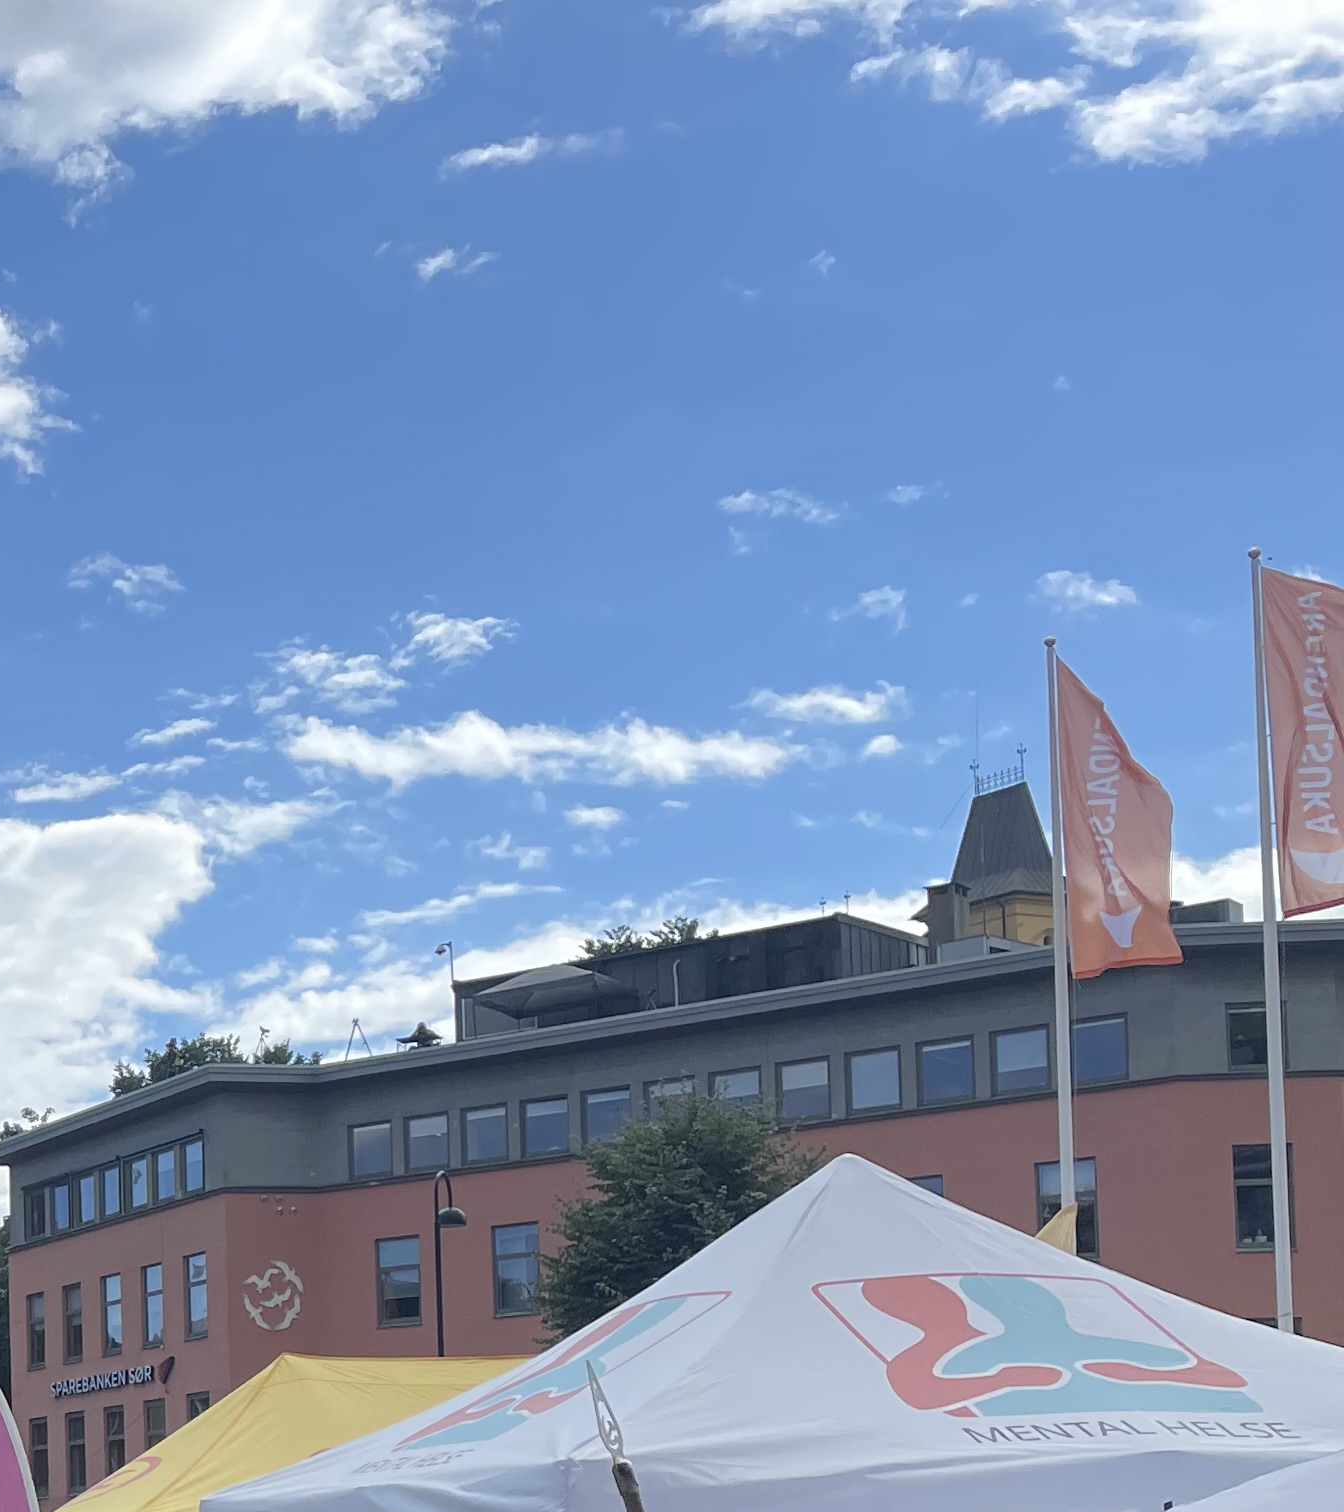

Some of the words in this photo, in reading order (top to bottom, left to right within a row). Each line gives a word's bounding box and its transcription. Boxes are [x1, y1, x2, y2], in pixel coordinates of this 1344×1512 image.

[50, 1371, 126, 1398] SPAREBANKEN
[128, 1365, 153, 1384] SØR
[961, 1420, 1155, 1445] MENTAL
[1159, 1419, 1302, 1441] HELSE
